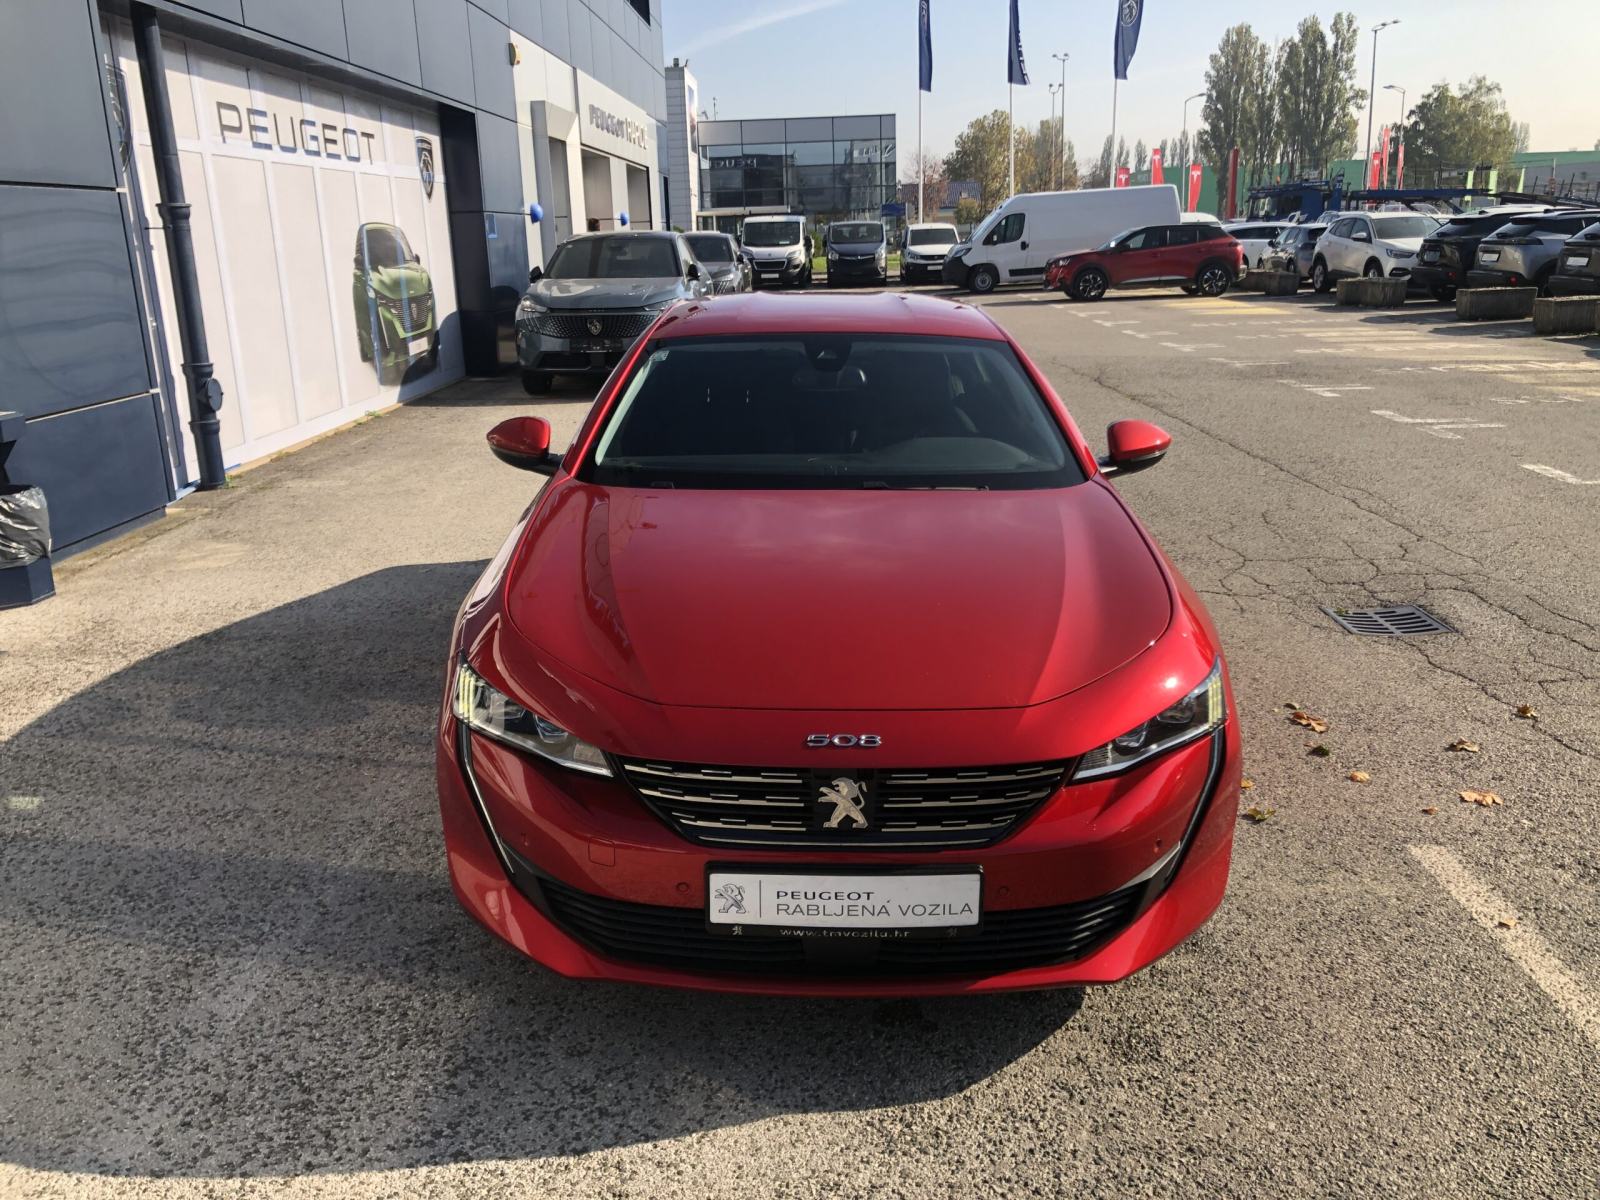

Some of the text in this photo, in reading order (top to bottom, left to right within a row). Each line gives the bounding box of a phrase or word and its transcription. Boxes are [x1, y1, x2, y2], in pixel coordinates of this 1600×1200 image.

[216, 101, 375, 165] PEUGEOT
[807, 734, 882, 747] 508
[776, 891, 875, 901] PEUGEOT
[776, 903, 973, 917] RABLJENA VOZILA
[779, 928, 911, 938] www.tmvozila.hr
